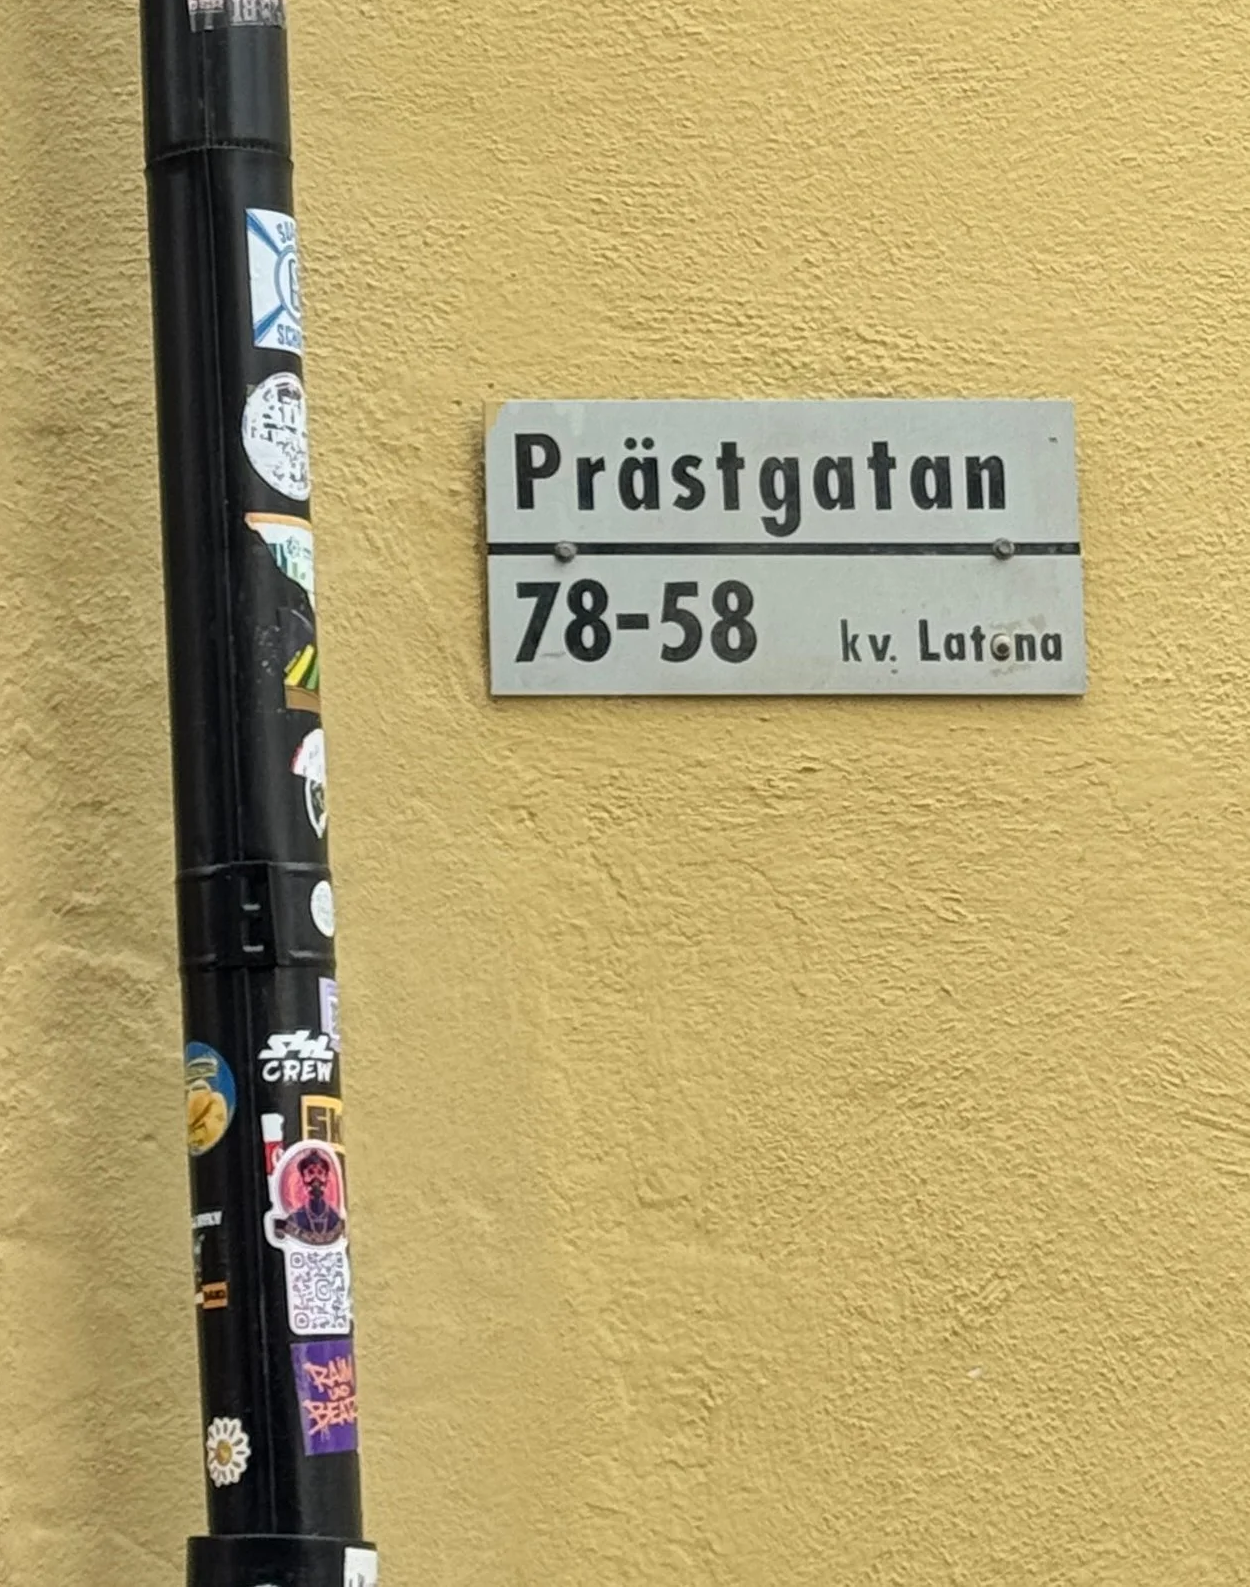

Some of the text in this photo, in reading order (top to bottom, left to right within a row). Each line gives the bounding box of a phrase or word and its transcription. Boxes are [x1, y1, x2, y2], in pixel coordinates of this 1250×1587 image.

[514, 432, 1006, 537] Prästgatan
[514, 578, 758, 663] 78-58
[841, 619, 898, 662] kv.
[262, 1061, 333, 1082] CREW
